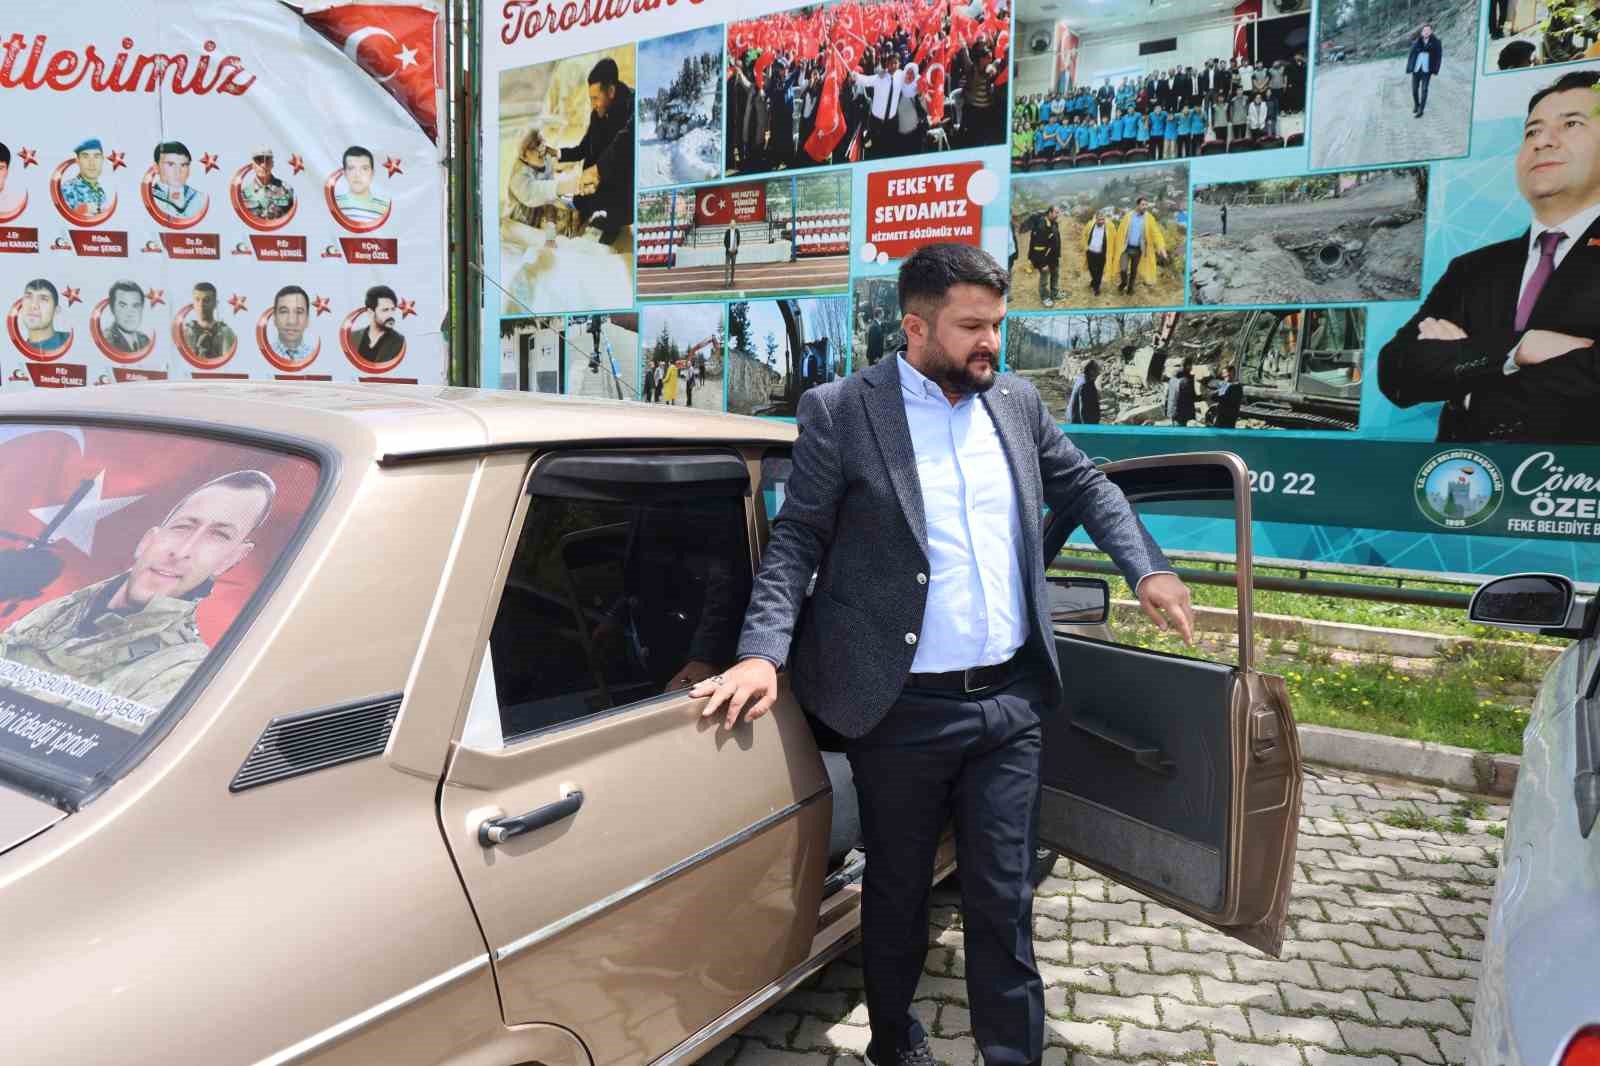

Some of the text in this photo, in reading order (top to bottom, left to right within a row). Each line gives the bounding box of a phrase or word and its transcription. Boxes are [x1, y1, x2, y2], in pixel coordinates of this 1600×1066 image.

[0, 33, 257, 96] tlerimiz
[887, 173, 955, 198] FEKE'YE
[874, 199, 968, 224] SEVDAMIZ
[871, 226, 973, 242] HİZMETE SÖZÜMÜZ VAR
[1282, 472, 1316, 495] 22
[1511, 451, 1600, 496] Cöm
[1530, 491, 1600, 519] ÖZE
[1507, 518, 1535, 532] FEKE
[1537, 520, 1592, 535] BELEDİYE
